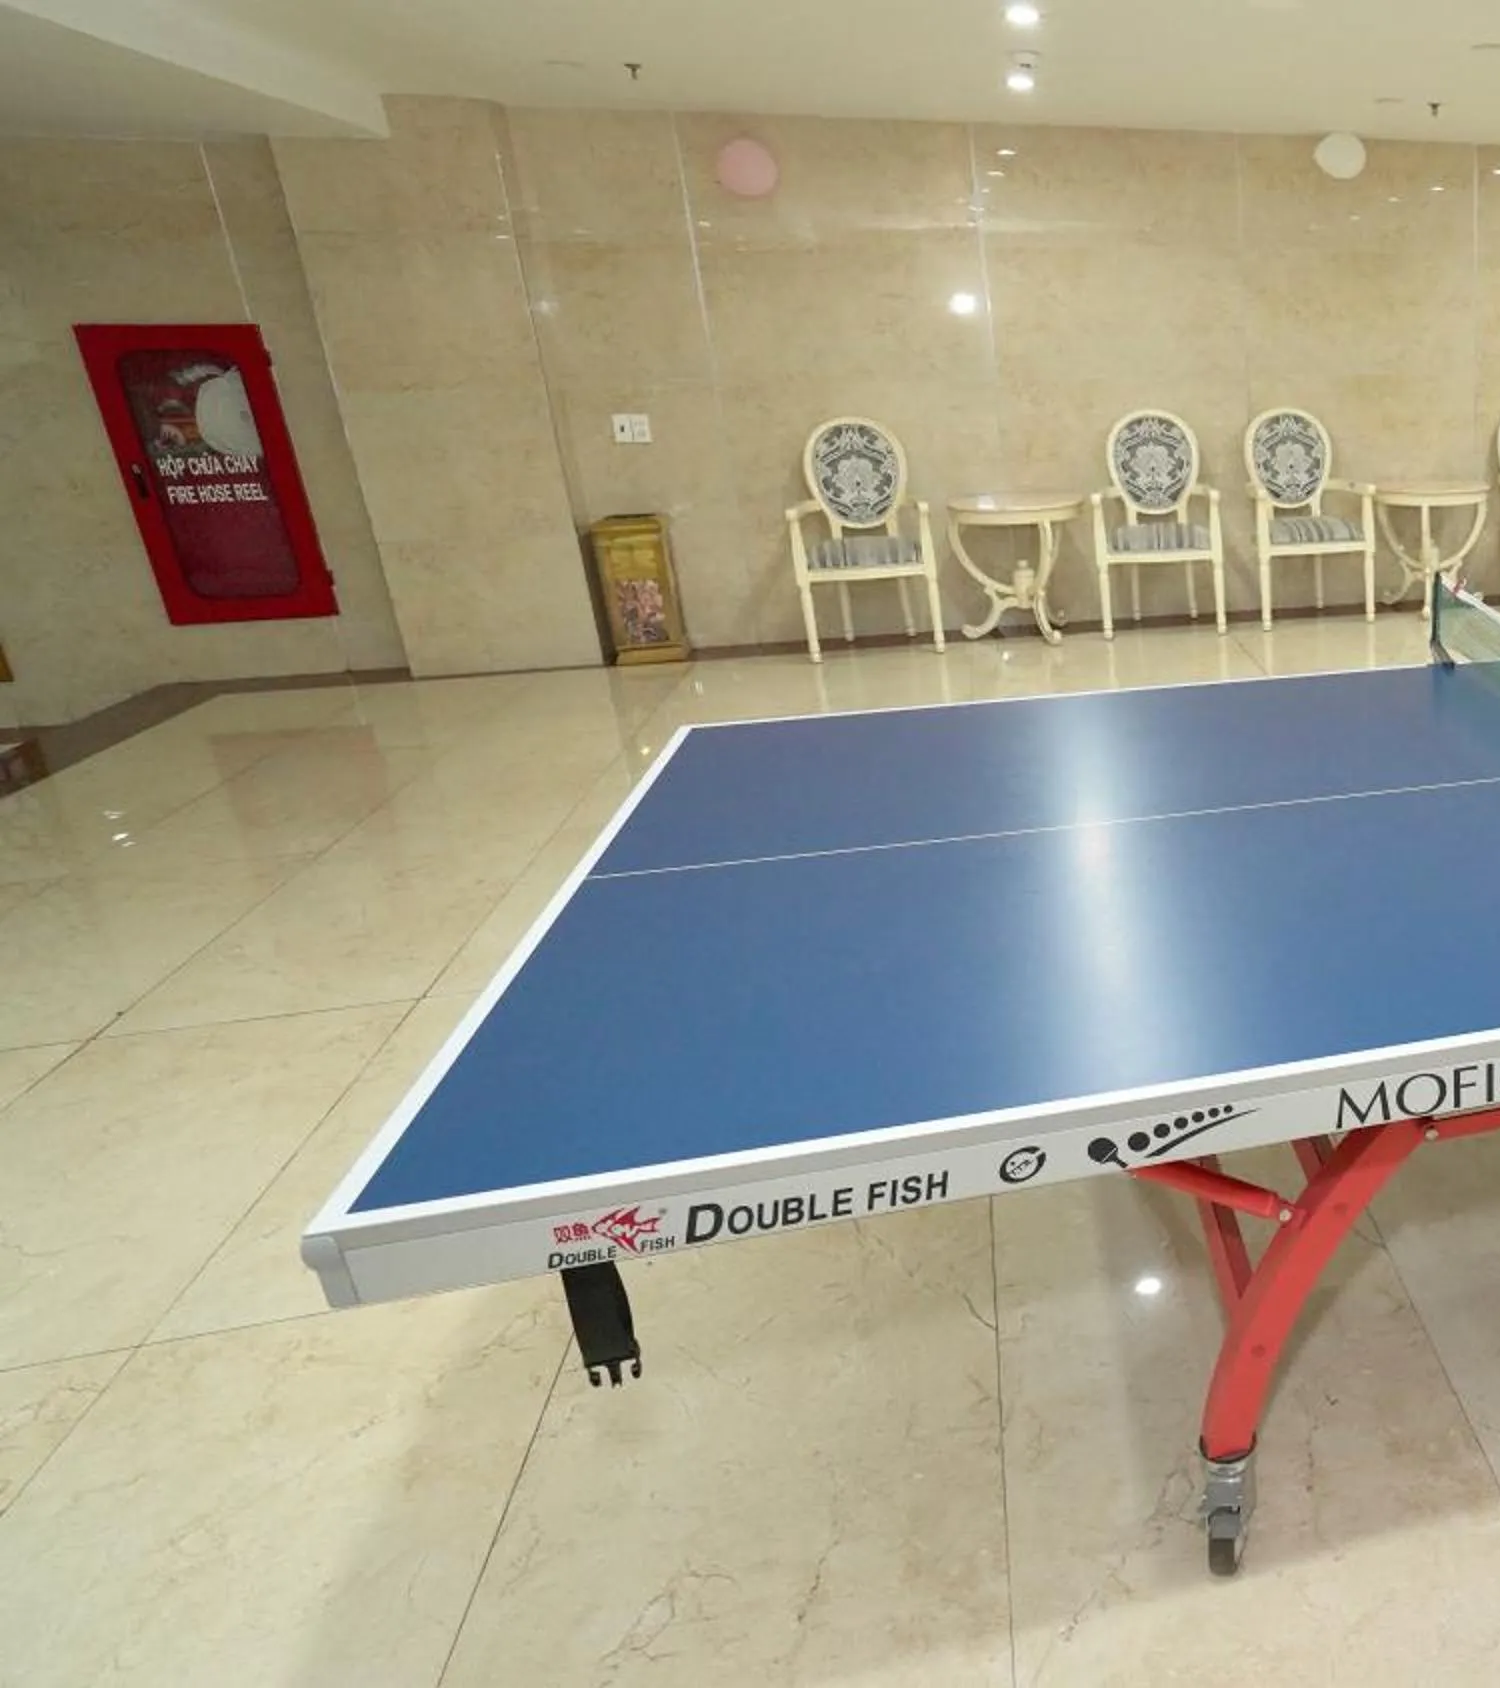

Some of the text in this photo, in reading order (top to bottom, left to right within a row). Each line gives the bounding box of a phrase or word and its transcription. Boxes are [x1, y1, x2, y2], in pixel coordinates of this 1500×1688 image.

[167, 483, 268, 505] FIRE HOSE REEL
[867, 1170, 949, 1211] FISH
[640, 1235, 676, 1253] FISH
